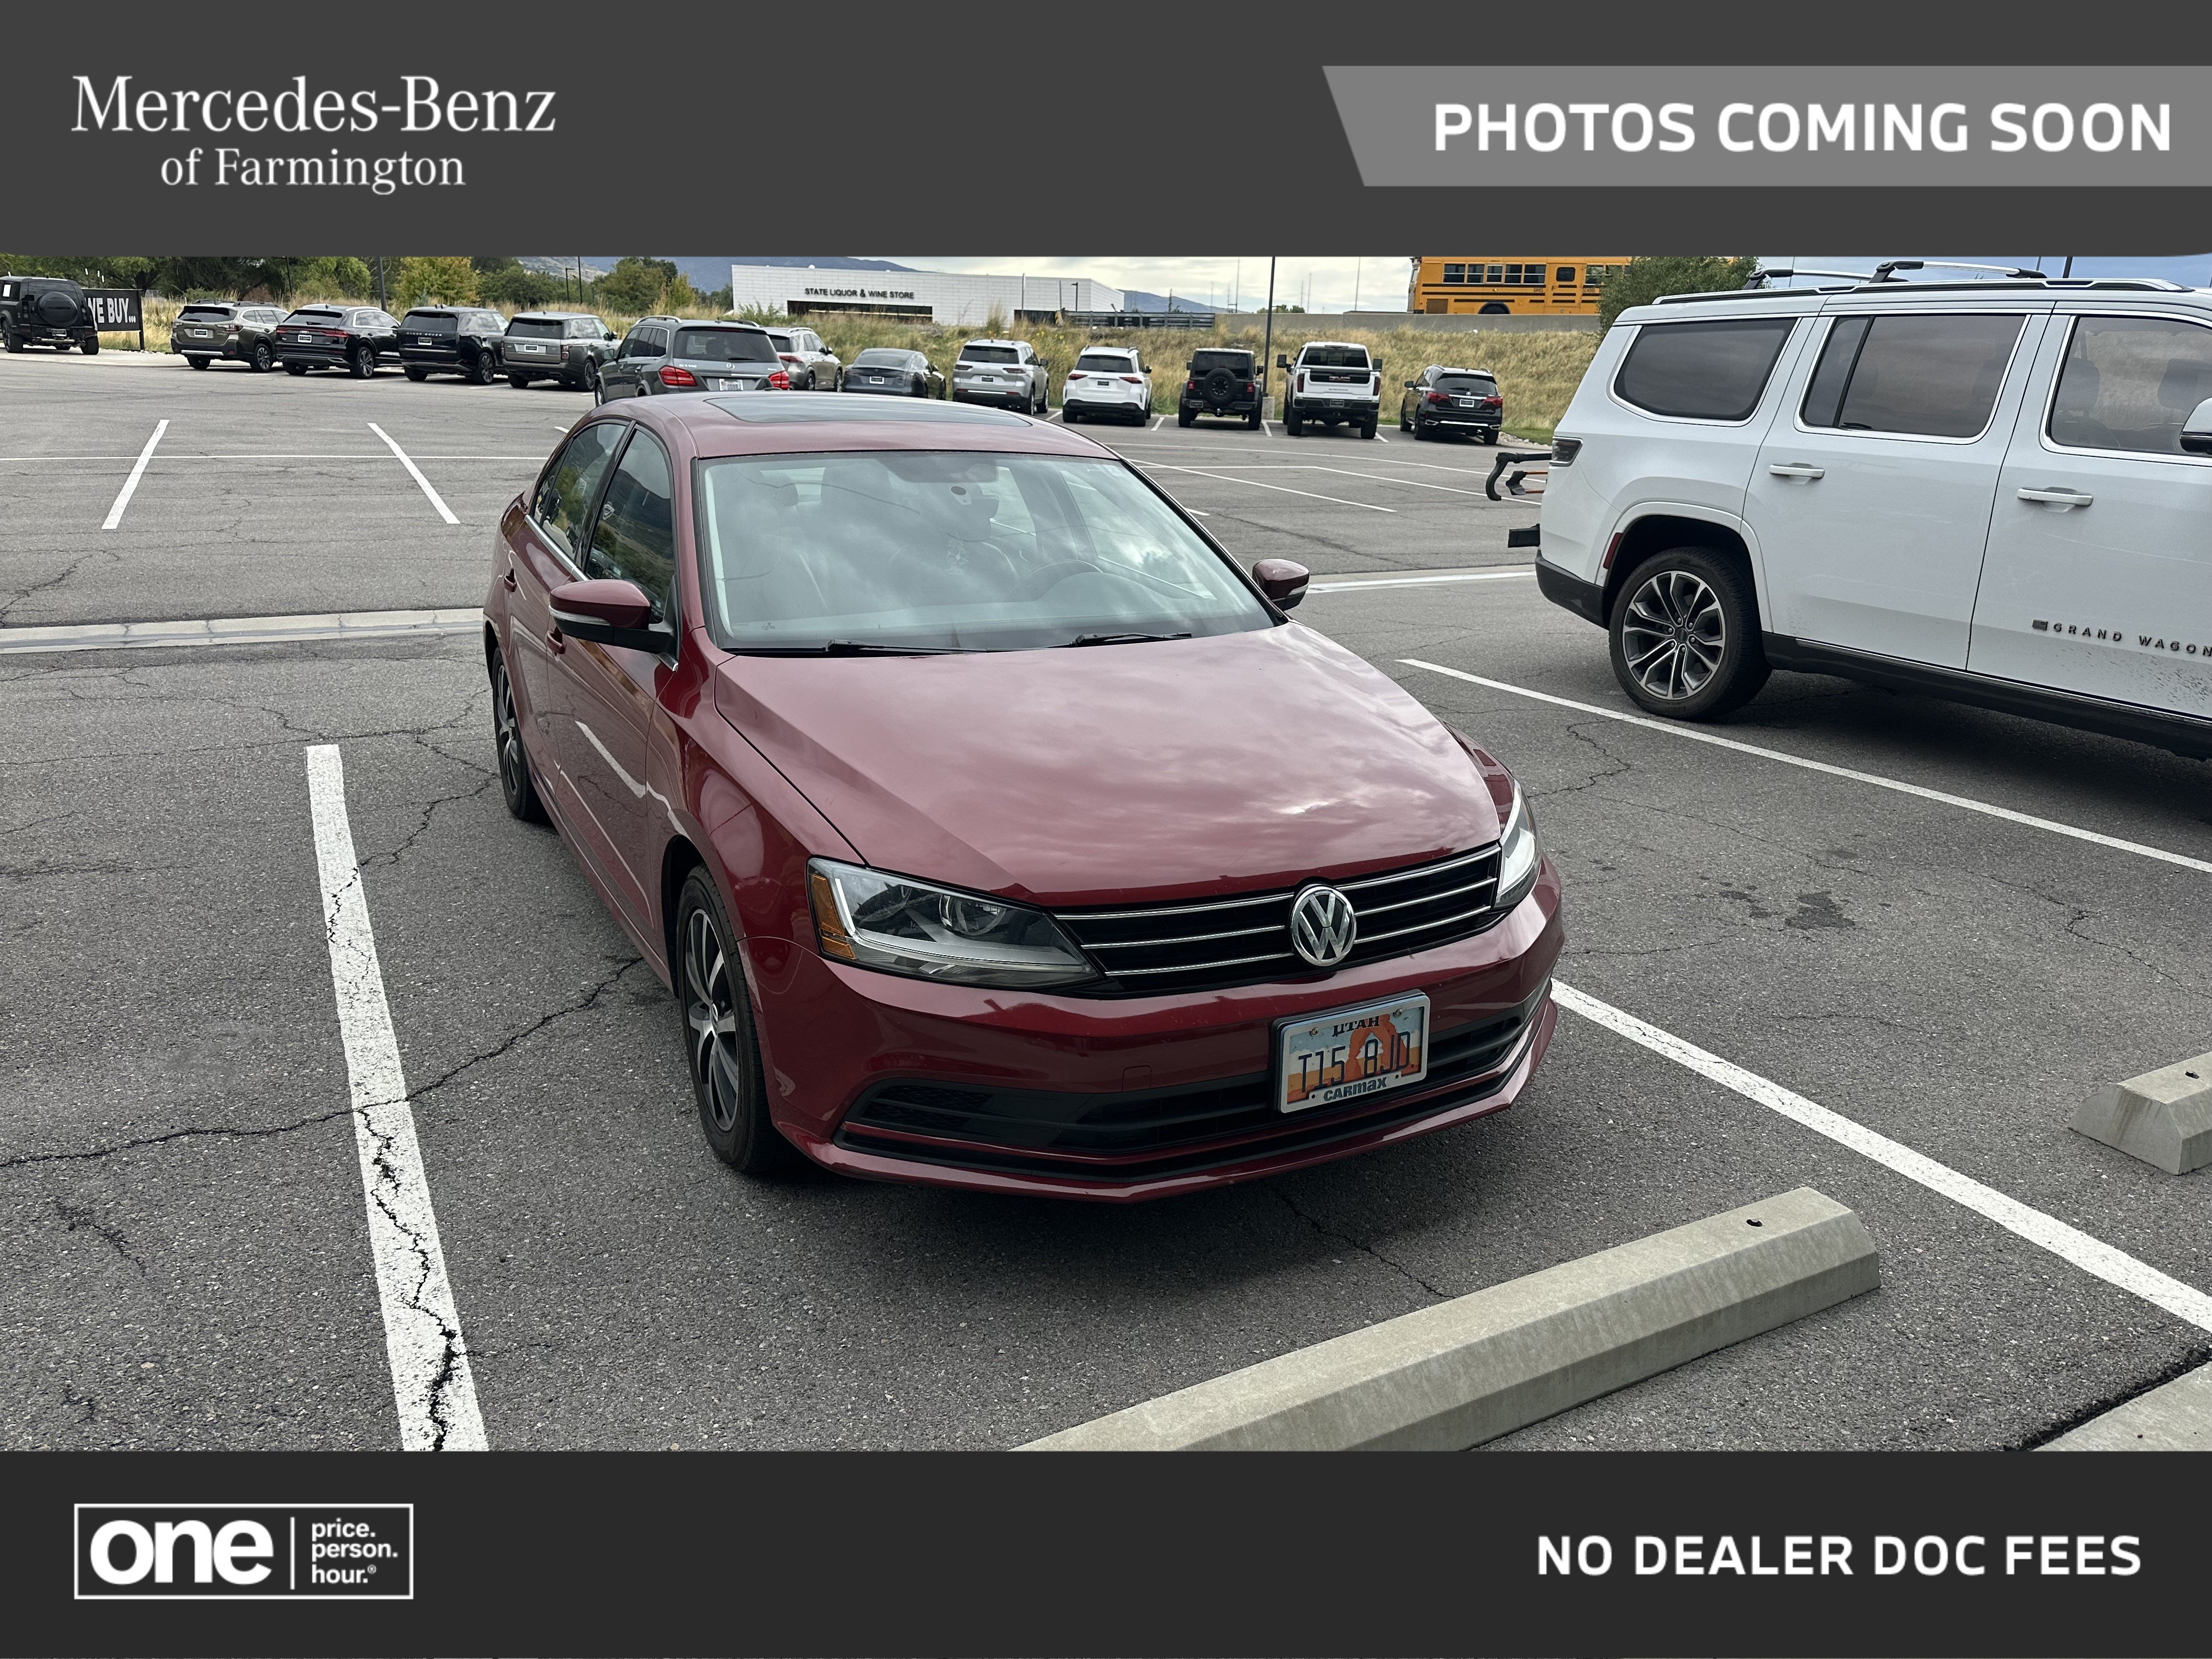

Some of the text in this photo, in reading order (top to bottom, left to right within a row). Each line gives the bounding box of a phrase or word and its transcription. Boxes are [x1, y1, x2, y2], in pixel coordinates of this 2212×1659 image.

[860, 289, 866, 297] &
[889, 291, 915, 299] STORE
[2053, 622, 2212, 657] GRAND WAGON
[1332, 1015, 1380, 1037] UTAH
